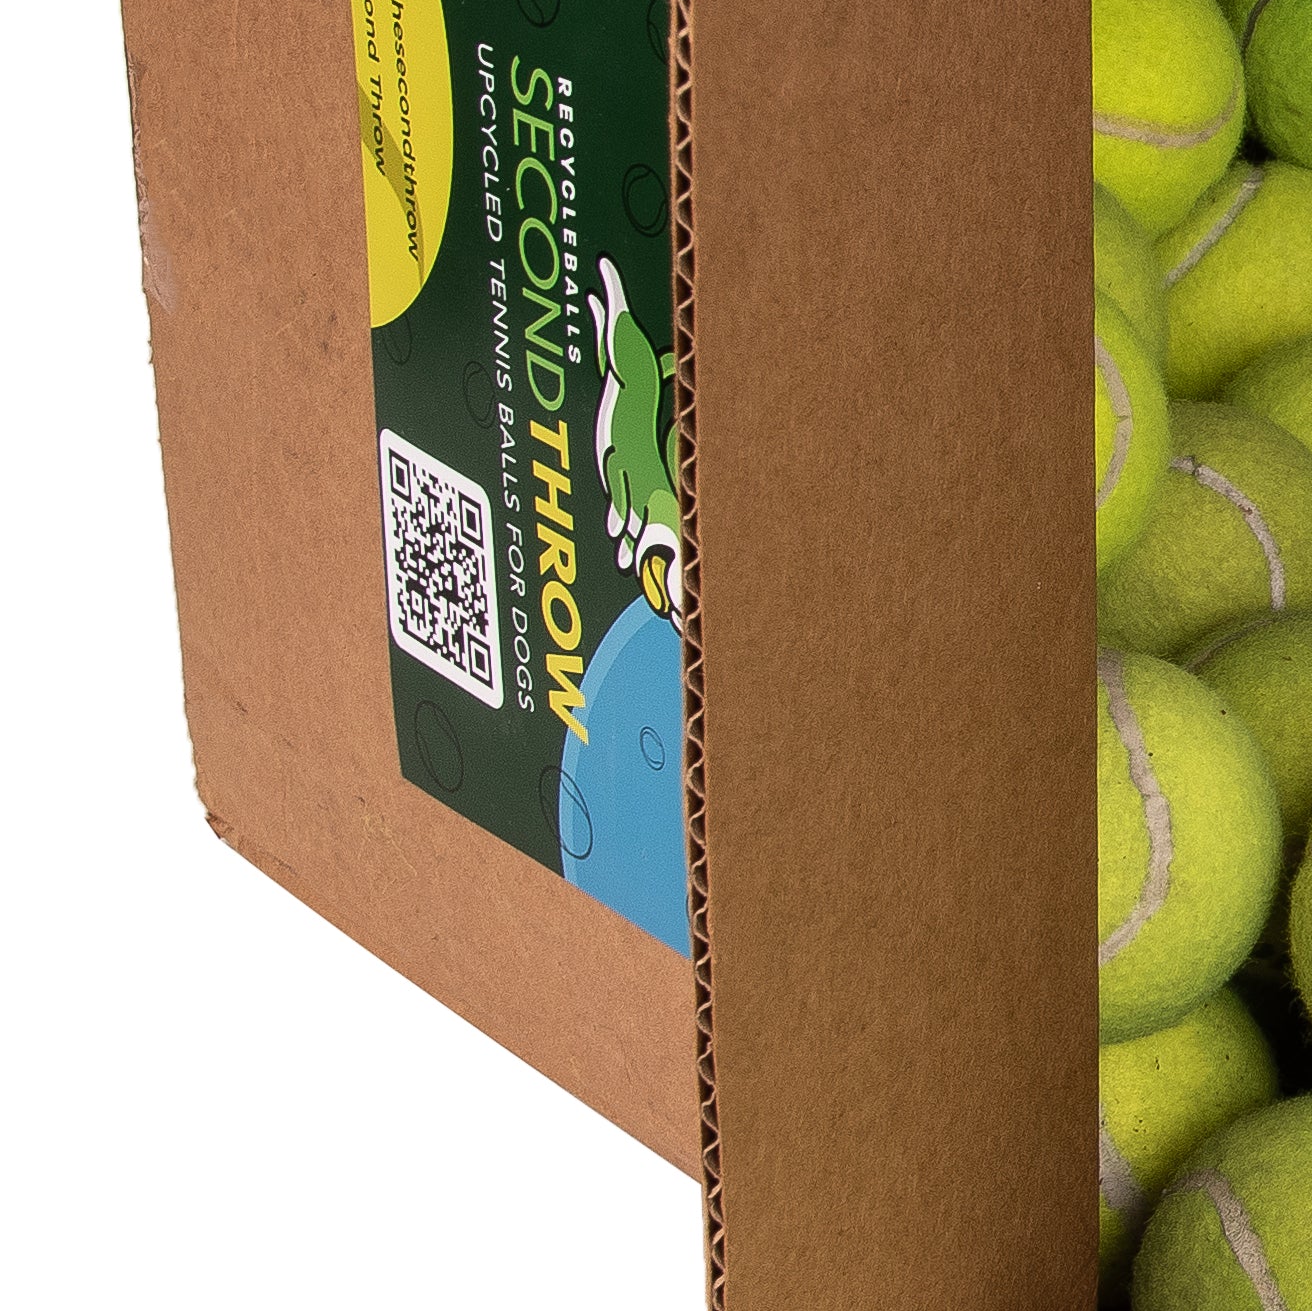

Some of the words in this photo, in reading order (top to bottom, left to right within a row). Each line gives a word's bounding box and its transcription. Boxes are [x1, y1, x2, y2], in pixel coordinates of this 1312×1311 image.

[370, 74, 387, 177] Throw
[478, 43, 502, 242] UPCYCLED
[558, 77, 581, 365] RECYCLEBALLS
[490, 259, 512, 392] TENNIS
[498, 403, 520, 512] BALLS
[506, 523, 526, 596] FOR
[511, 606, 534, 712] DOGS
